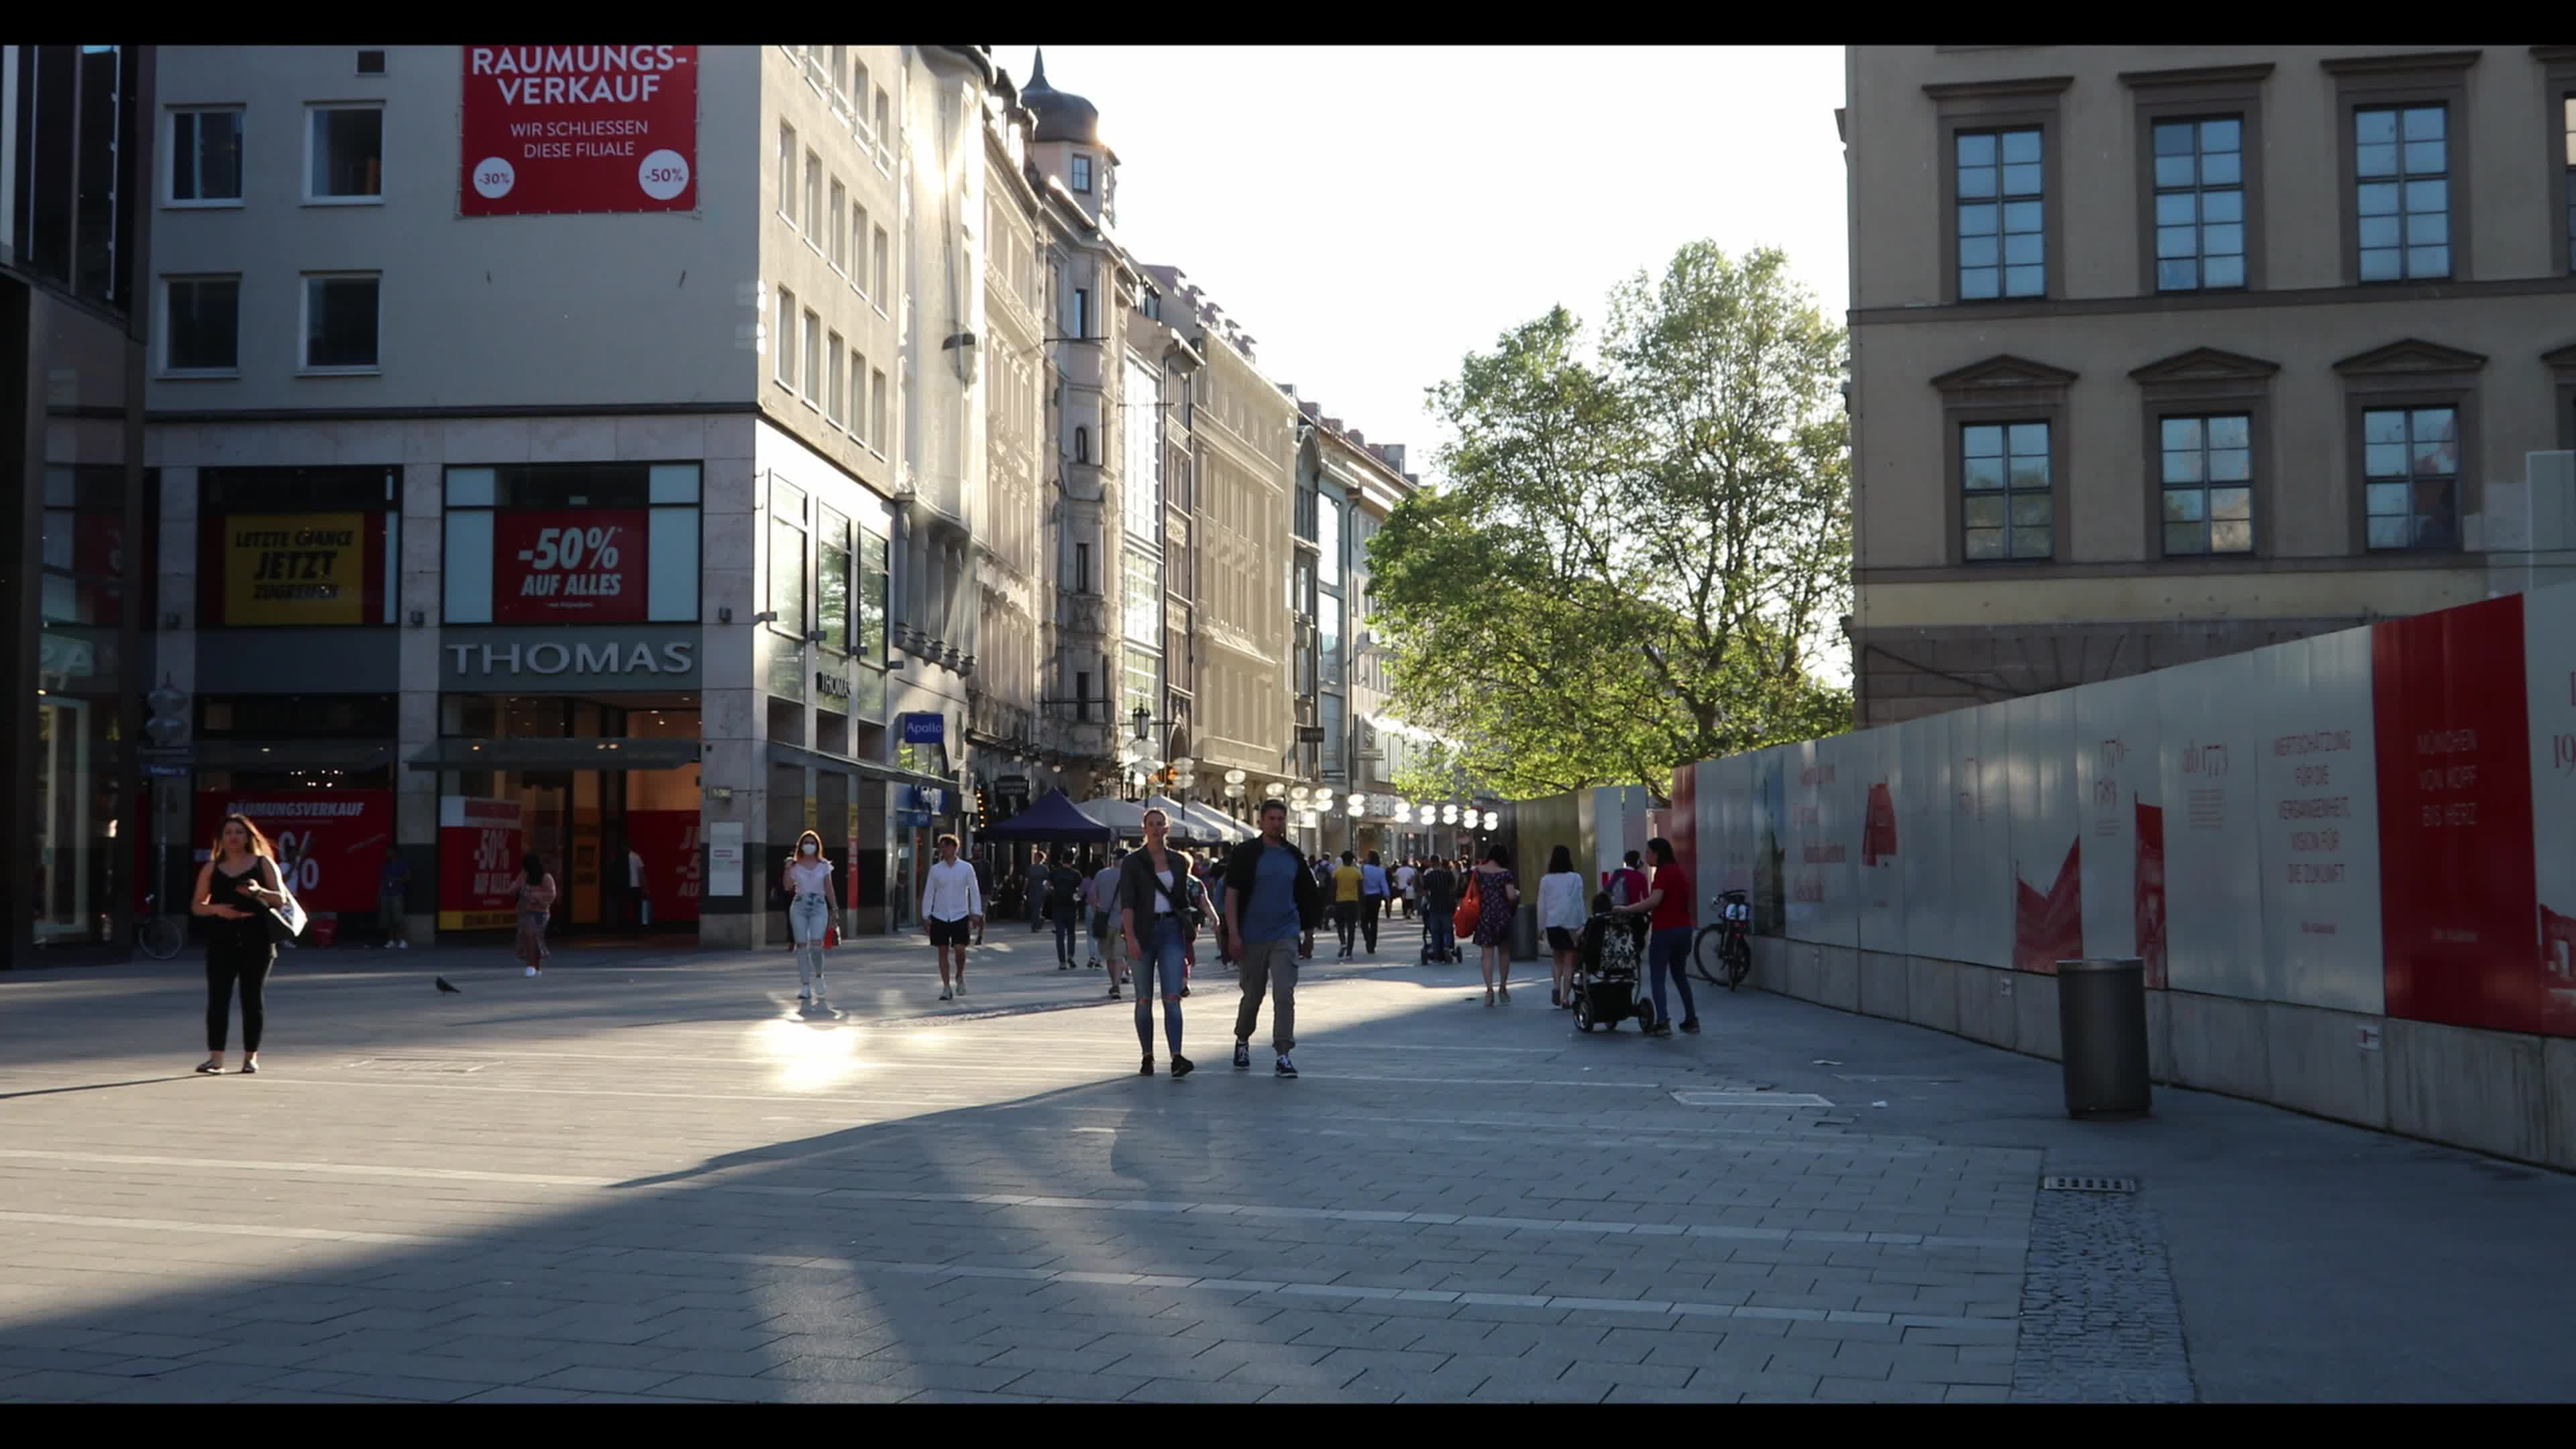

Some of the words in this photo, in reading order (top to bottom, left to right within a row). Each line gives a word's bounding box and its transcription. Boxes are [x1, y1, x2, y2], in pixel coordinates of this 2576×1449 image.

[496, 74, 660, 105] VERKAUF
[510, 122, 542, 137] WIR
[547, 119, 649, 137] SCHLIESSEN
[523, 142, 572, 158] DIESE
[576, 141, 635, 157] FILIALE
[478, 172, 511, 185] -30%
[644, 168, 684, 183] -50%
[252, 550, 338, 580] JETZT
[520, 574, 561, 596] AUF
[563, 573, 623, 596] ALLES
[445, 641, 694, 676] THOMAS
[906, 721, 943, 736] Apollo
[226, 800, 366, 817] RÄUMUNGSVERKAUF
